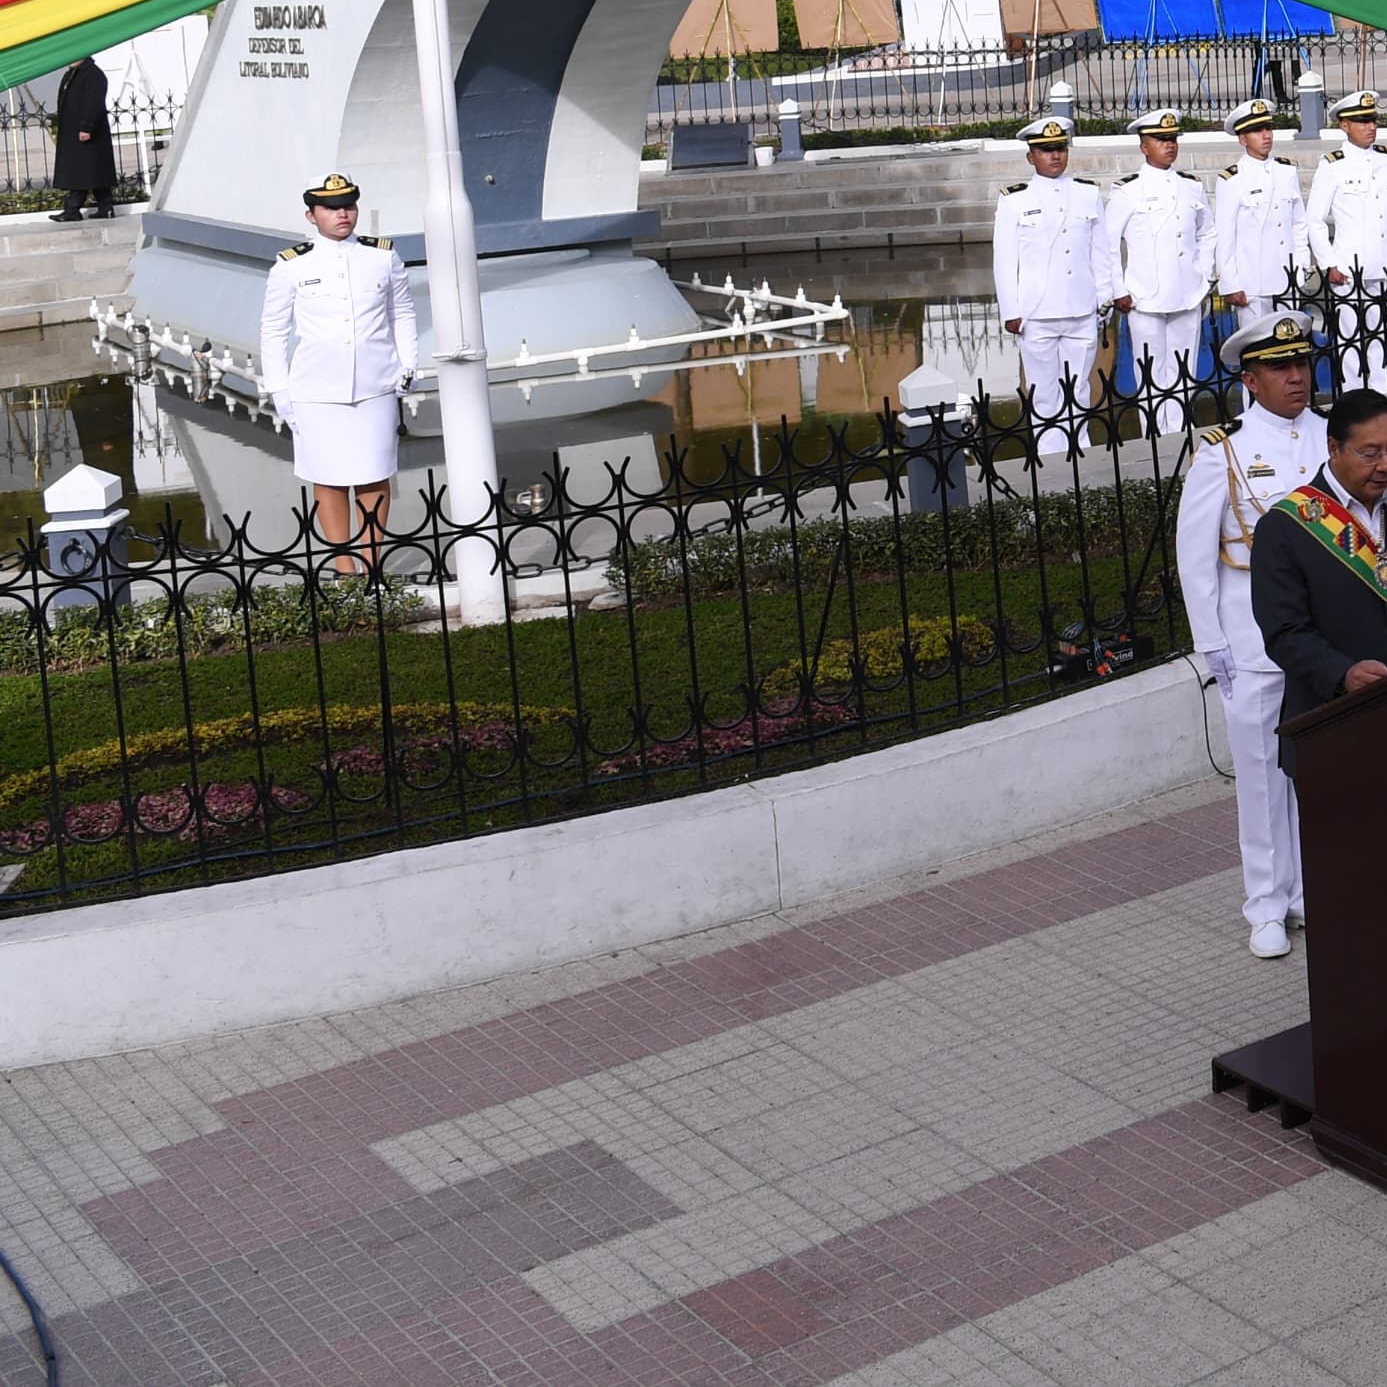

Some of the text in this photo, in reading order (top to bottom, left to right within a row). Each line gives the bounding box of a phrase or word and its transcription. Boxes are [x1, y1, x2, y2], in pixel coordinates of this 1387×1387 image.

[254, 5, 327, 30] EDUARDO ABAROA
[248, 38, 304, 54] DEFENSOR DEL
[239, 62, 309, 78] LITORAL BOLIVIANO
